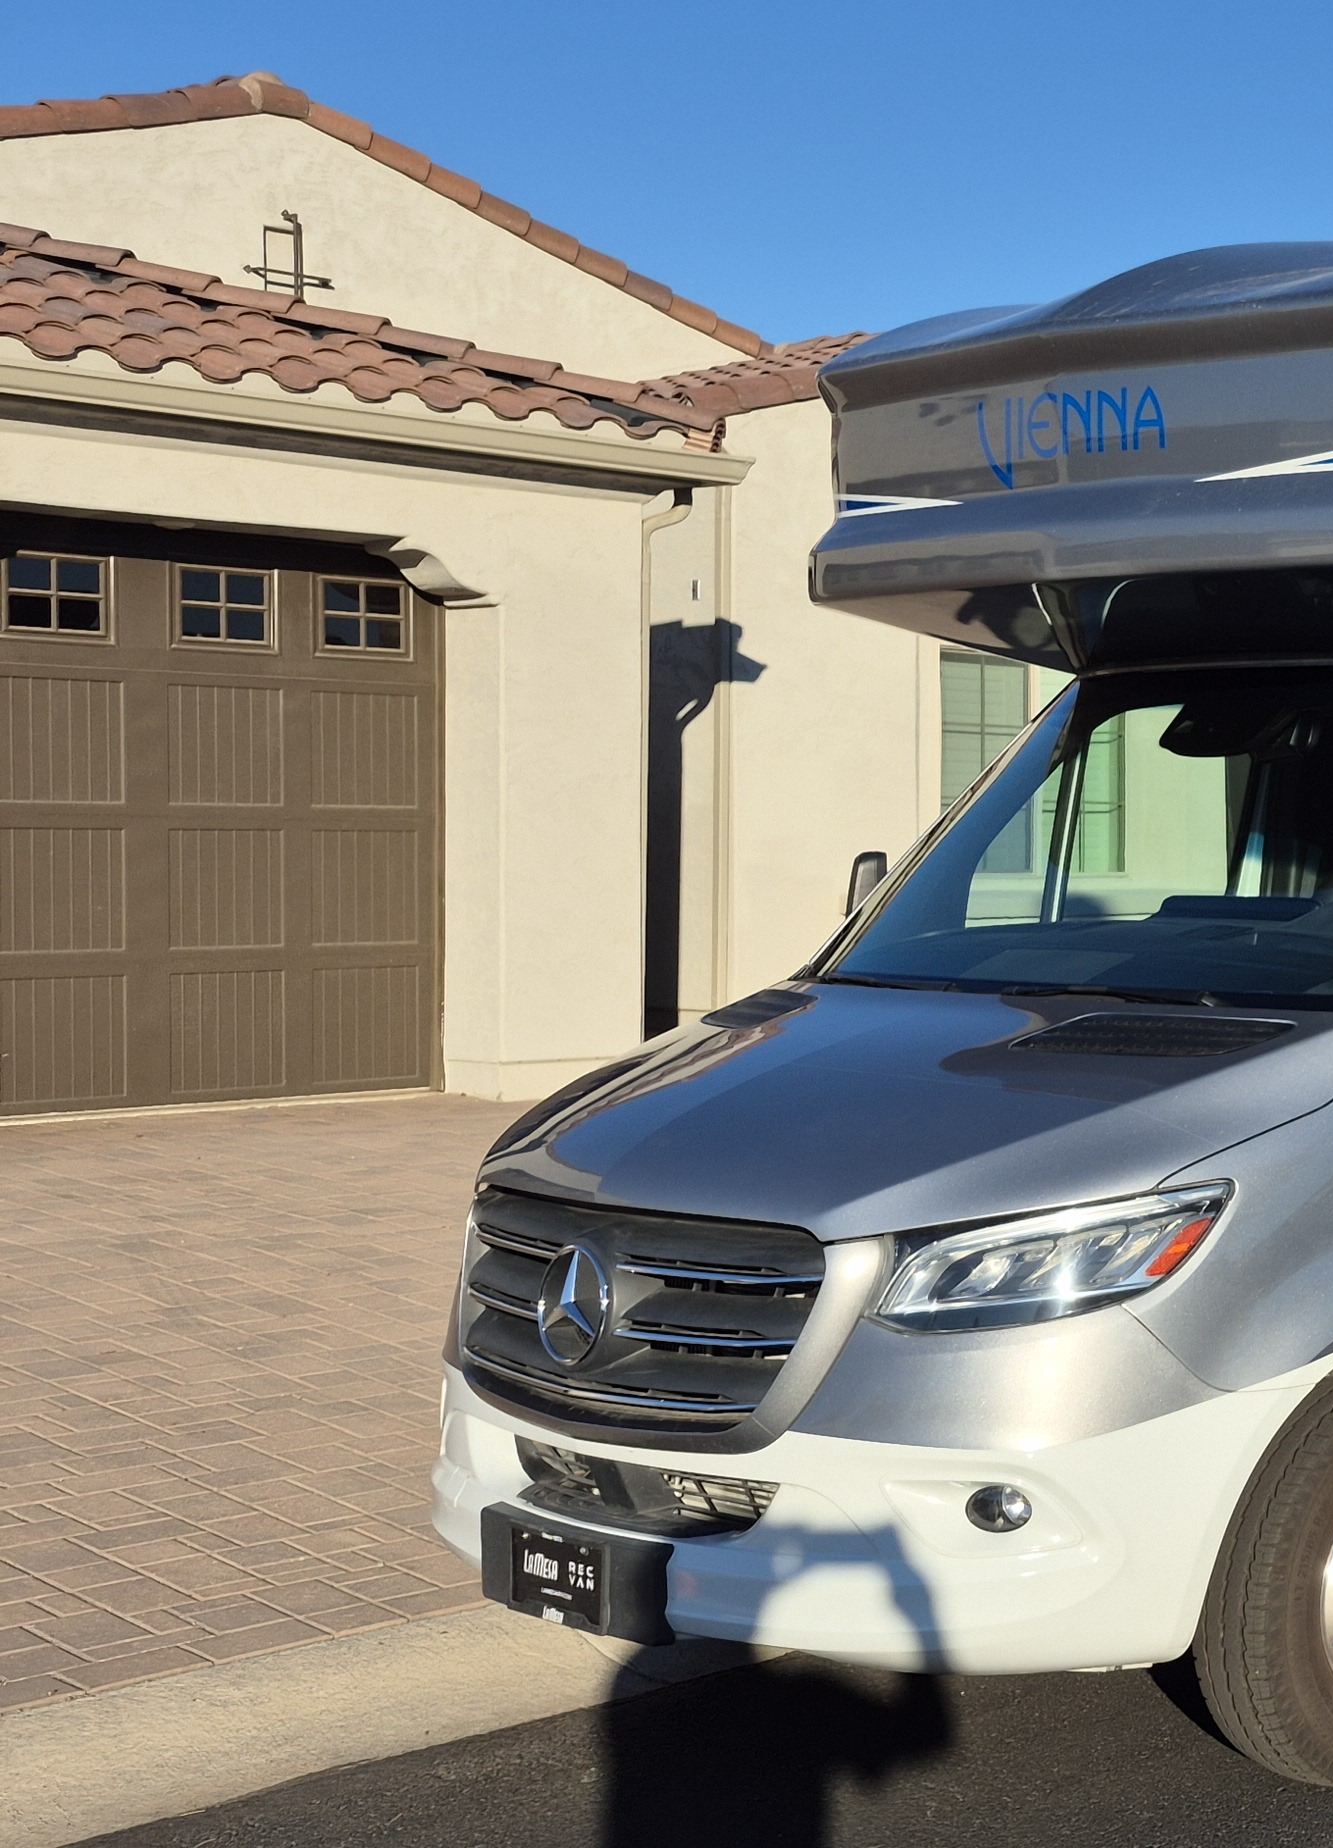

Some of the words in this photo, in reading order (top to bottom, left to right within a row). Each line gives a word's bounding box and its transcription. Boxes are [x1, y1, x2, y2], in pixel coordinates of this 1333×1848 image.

[977, 386, 1167, 490] VIENNA
[568, 1561, 595, 1578] REC
[568, 1573, 595, 1592] VAN
